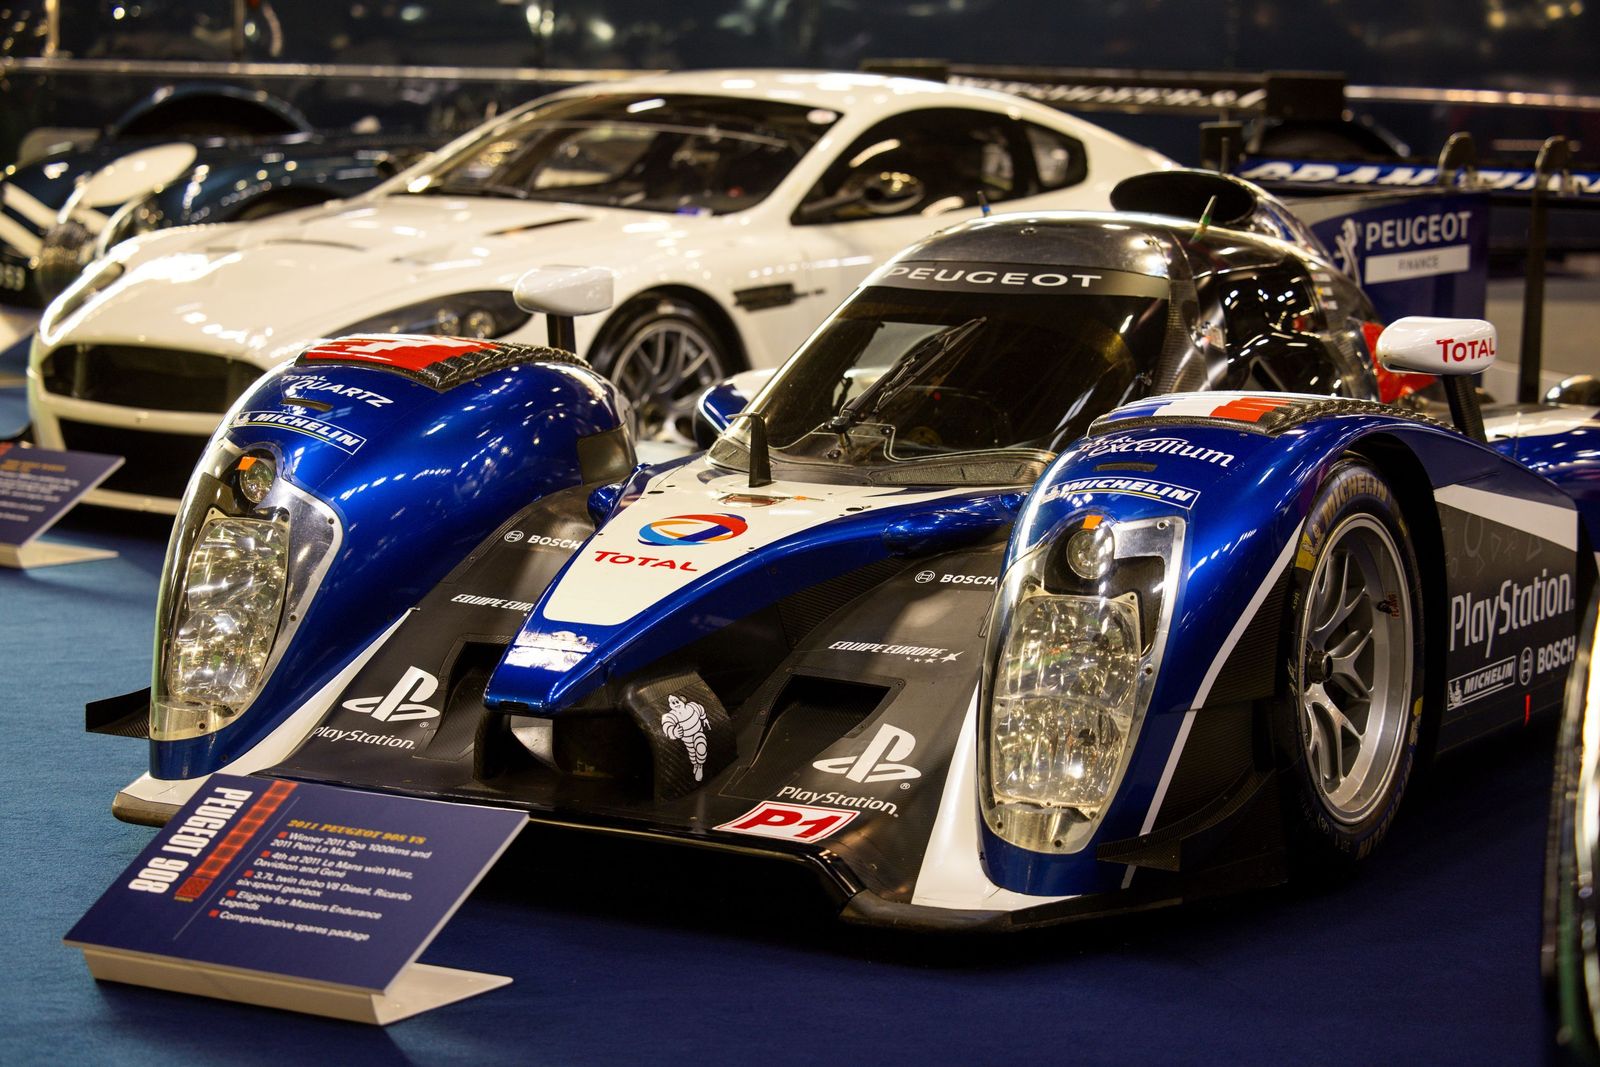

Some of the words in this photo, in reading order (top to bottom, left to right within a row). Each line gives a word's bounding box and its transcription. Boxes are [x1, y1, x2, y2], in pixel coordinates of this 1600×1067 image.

[1365, 211, 1471, 250] PEUGEOT
[883, 267, 1102, 288] PEUGEOT
[1436, 337, 1495, 363] TOTAL
[289, 380, 394, 408] QUARTZ
[253, 412, 361, 447] MICHELIN
[1064, 478, 1195, 502] MICHELIN
[1322, 472, 1388, 524] MICHELIN
[527, 534, 584, 550] BOSCH
[594, 550, 699, 572] TOTAL
[939, 573, 999, 586] BOSCH
[451, 593, 505, 608] EQUIPE
[1449, 568, 1571, 659] PlayStation
[828, 640, 885, 653] EQUIPE
[882, 644, 949, 658] EUROPE
[1536, 635, 1576, 674] BOSCH
[1463, 661, 1514, 695] MICHELIN
[776, 786, 898, 817] PlayStation
[162, 786, 253, 858] PEUGEOT
[287, 819, 319, 830] 2011
[319, 823, 383, 839] PEUGEOT
[732, 808, 843, 838] P1
[270, 839, 292, 848] 2011
[293, 841, 314, 851] Petit
[315, 845, 328, 854] Le
[328, 848, 357, 858] Mans
[288, 832, 324, 844] Winner
[324, 837, 346, 847] 2011
[346, 840, 366, 851] Spa
[368, 843, 411, 856] 1000kms
[411, 850, 432, 859] and
[128, 857, 189, 894] 908
[253, 858, 298, 873] Davidson
[298, 864, 319, 875] and
[271, 852, 288, 861] 4th
[299, 856, 322, 866] 2011
[322, 858, 335, 868] Le
[335, 861, 364, 872] Mans
[364, 866, 386, 875] with
[254, 871, 274, 881] 3.7L
[275, 874, 298, 885] twin
[298, 878, 325, 890] turbo
[325, 881, 340, 890] V8
[373, 889, 413, 901] Ricardo
[282, 884, 323, 898] gearbox
[219, 897, 260, 911] Legends
[236, 890, 273, 905] Eligible
[273, 896, 289, 906] for
[289, 898, 329, 912] Masters
[329, 905, 383, 919] Endurance
[219, 910, 295, 930] Comprehensive
[295, 924, 328, 935] spares
[327, 928, 370, 941] package
